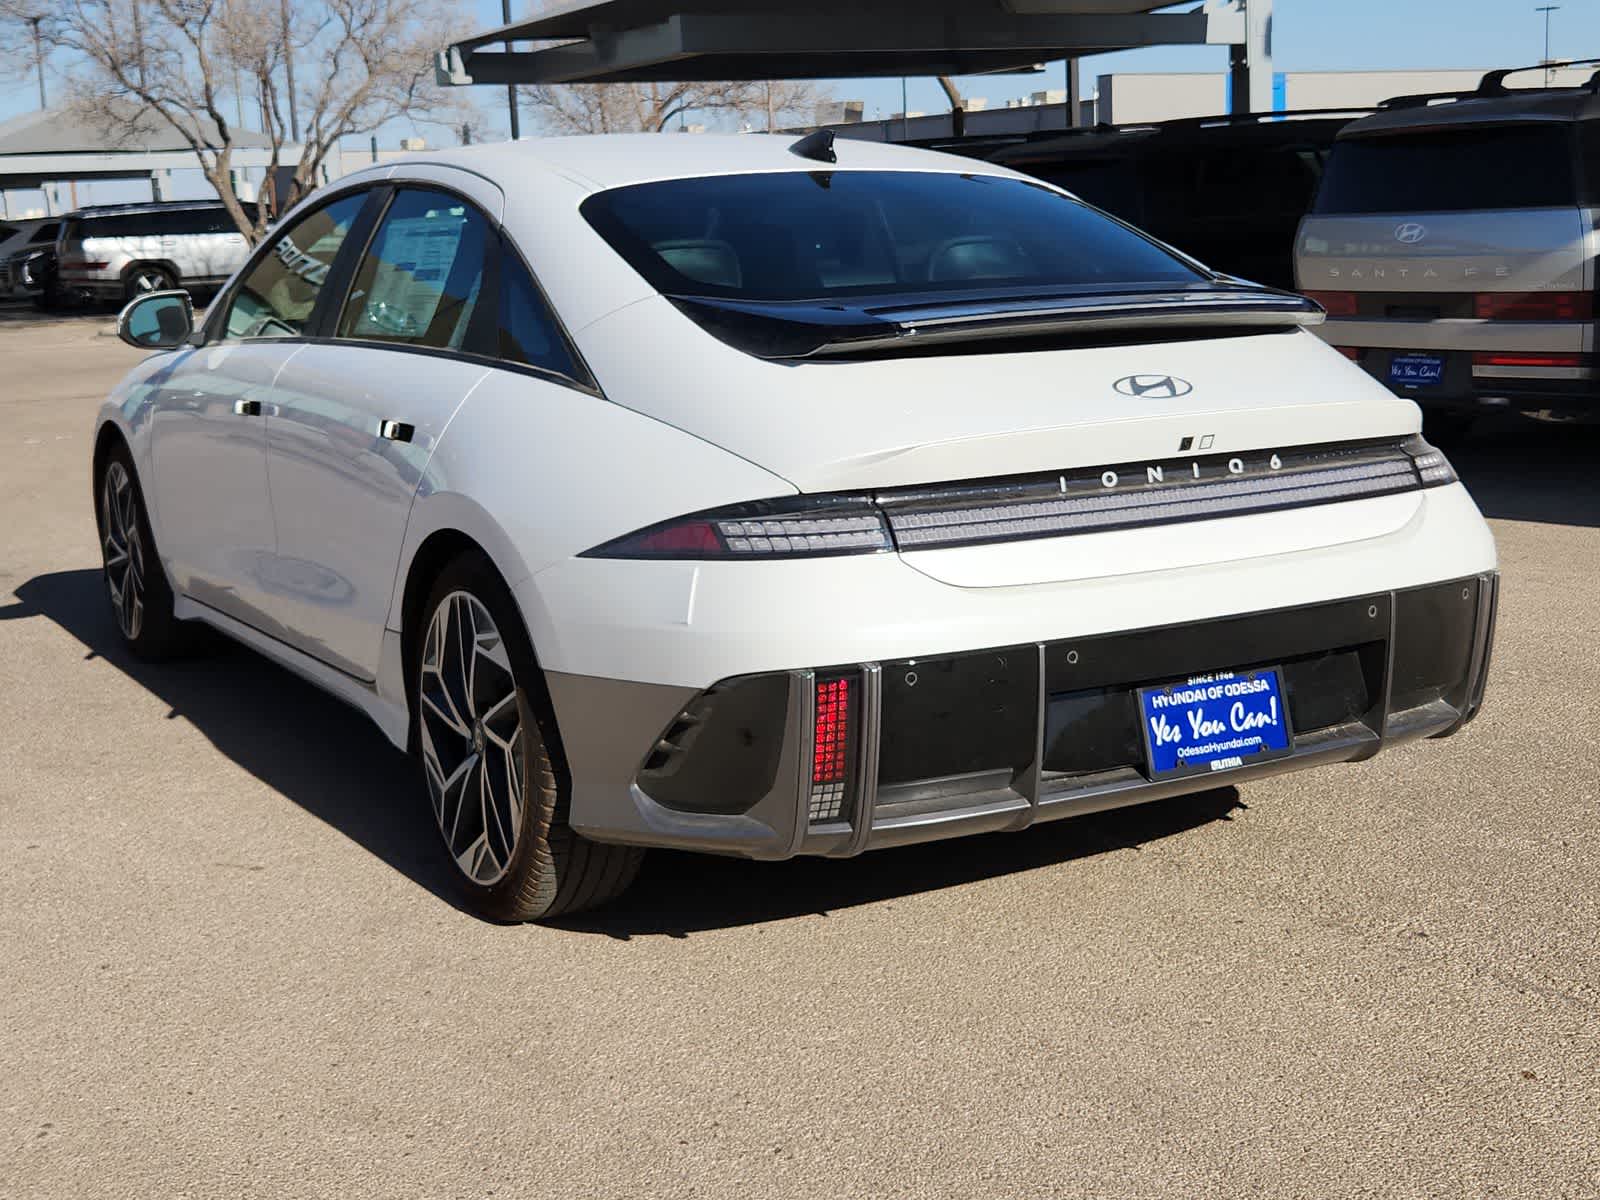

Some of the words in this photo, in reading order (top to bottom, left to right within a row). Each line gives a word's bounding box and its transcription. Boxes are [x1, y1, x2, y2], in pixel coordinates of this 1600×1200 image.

[1328, 267, 1438, 279] SANTA
[1464, 266, 1512, 278] FE
[1059, 457, 1245, 494] IONIQ
[1269, 453, 1282, 470] 6
[1187, 672, 1214, 686] SINCE
[1152, 688, 1207, 708] HYUNDAI
[1207, 686, 1224, 700] OF
[1224, 679, 1271, 697] ODESSA
[1150, 712, 1182, 746] Yes
[1187, 708, 1226, 740] You
[1230, 695, 1277, 732] Can!
[1177, 735, 1262, 758] OdessaHyundai.com
